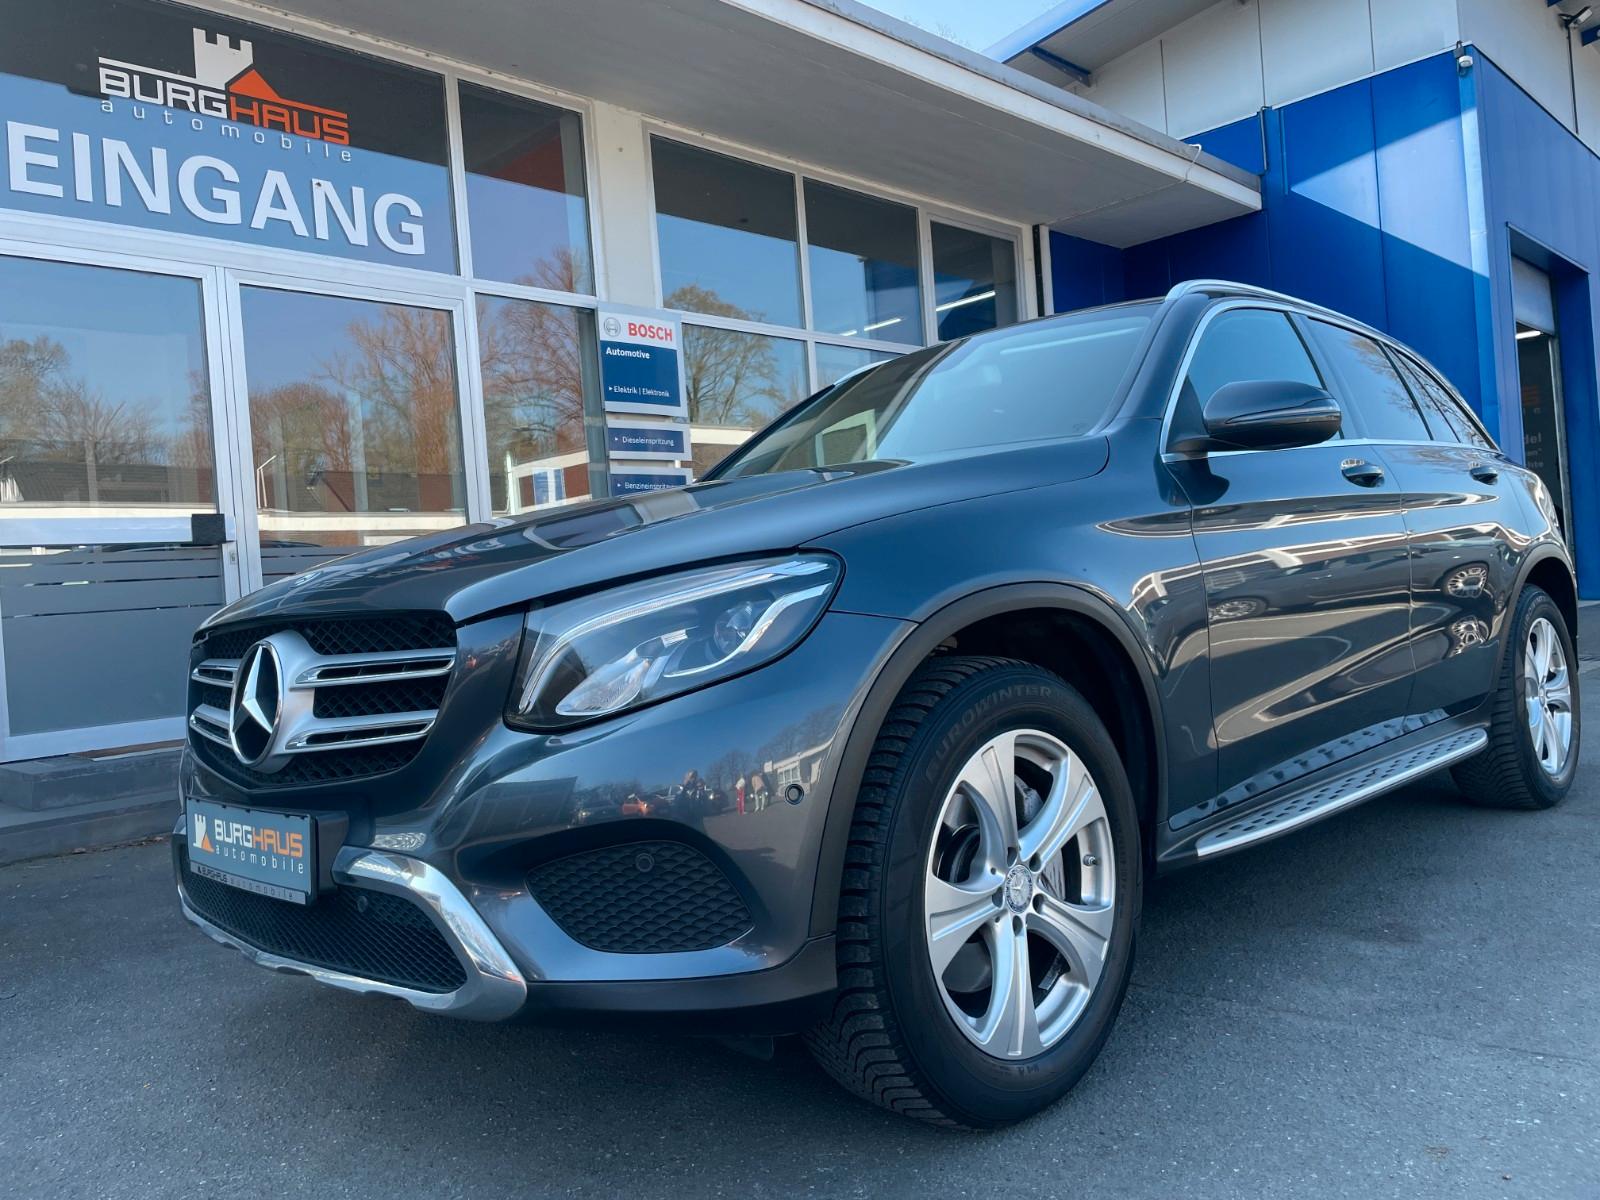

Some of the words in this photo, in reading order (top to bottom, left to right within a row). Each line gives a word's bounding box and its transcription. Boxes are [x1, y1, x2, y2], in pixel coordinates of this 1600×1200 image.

[99, 67, 350, 146] BURGHAUS
[101, 100, 352, 163] automobile
[6, 120, 426, 256] EINGANG
[628, 322, 673, 342] BOSCH
[605, 347, 651, 360] Automotive
[613, 385, 638, 395] Elektrik
[642, 387, 670, 398] Elektronik
[622, 436, 675, 447] Dieseleinspritzung
[214, 819, 304, 858] BURGHAUS
[215, 844, 304, 874] automobile
